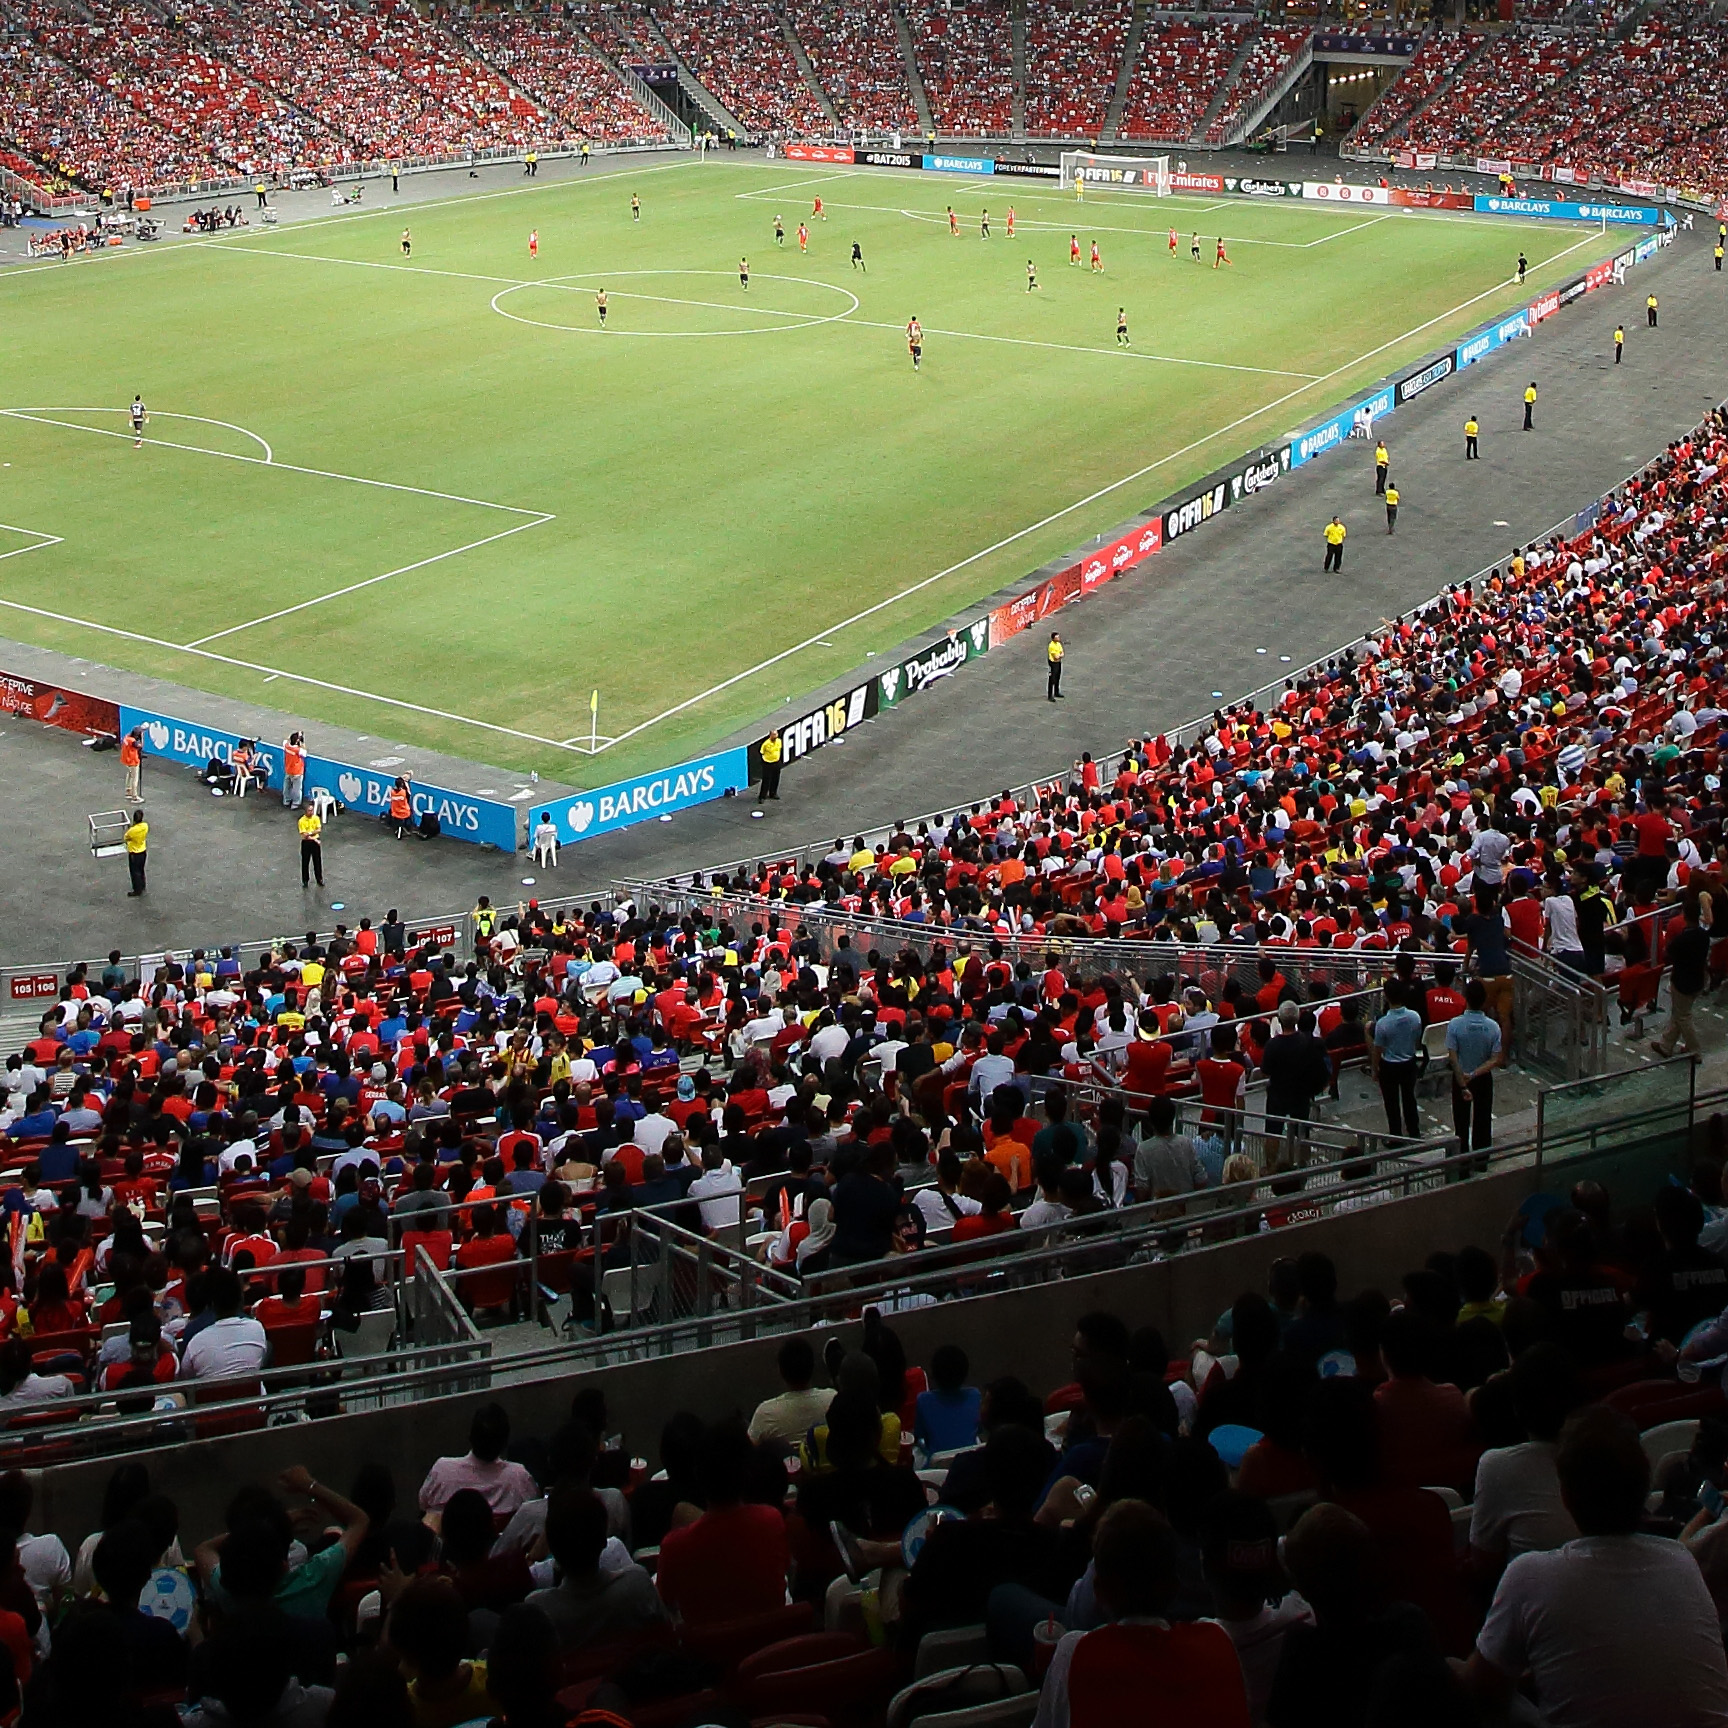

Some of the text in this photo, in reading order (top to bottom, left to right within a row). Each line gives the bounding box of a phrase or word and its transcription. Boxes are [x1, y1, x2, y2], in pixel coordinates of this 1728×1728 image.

[866, 153, 911, 167] #BAT2015
[944, 161, 983, 171] BARCLAYS
[1168, 173, 1219, 189] Emirates
[1240, 178, 1285, 195] Carlsberg
[1501, 201, 1550, 213] BARCLAYS
[1591, 207, 1643, 220] BARCLAYS
[1537, 295, 1559, 320] Emirates
[1308, 422, 1339, 453] BARCLAYS
[1244, 461, 1279, 494] Carlsberg
[905, 639, 967, 689] Probably
[174, 728, 274, 778] BARCLYS
[598, 765, 715, 823] BARCLAYS
[367, 780, 480, 832] BACLAYS
[436, 933, 453, 944] 107
